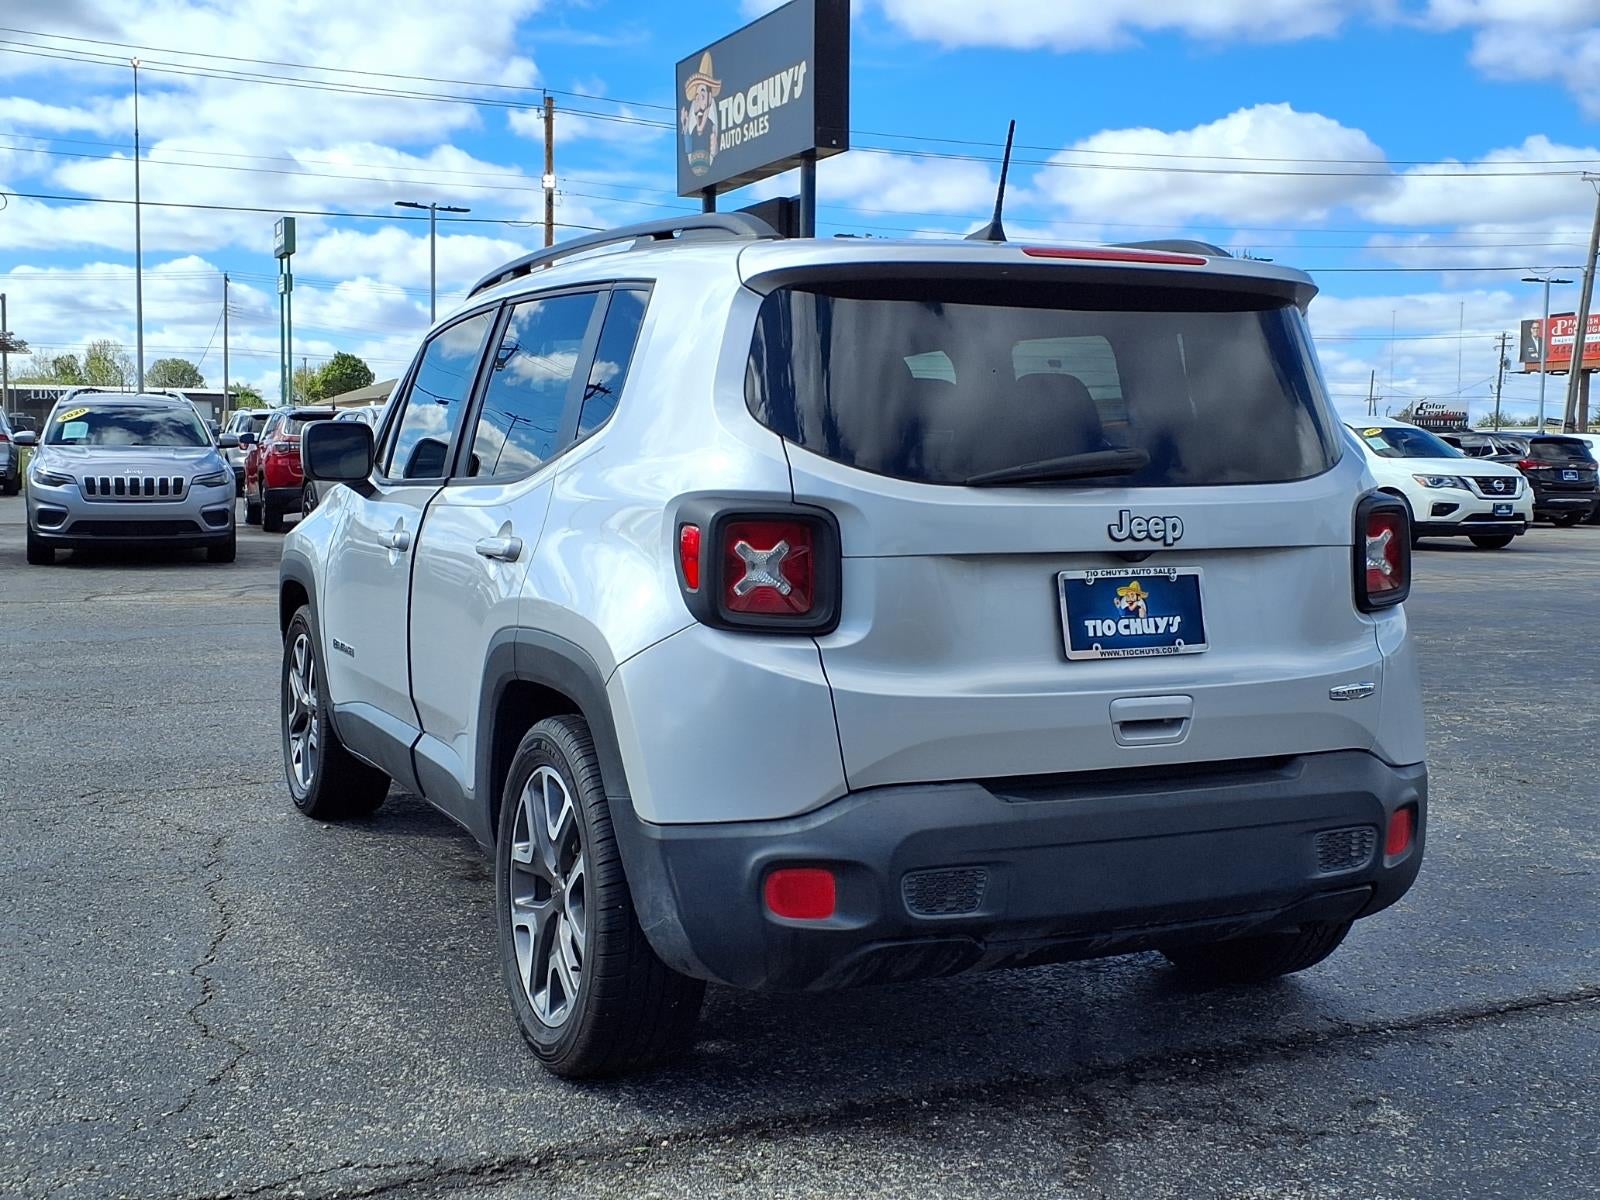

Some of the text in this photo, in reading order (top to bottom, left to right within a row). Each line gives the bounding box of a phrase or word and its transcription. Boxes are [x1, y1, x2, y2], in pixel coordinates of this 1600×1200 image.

[718, 60, 807, 131] TIO CHUY'S
[720, 115, 769, 151] AUTO SALES
[1415, 407, 1467, 417] Creations
[1419, 401, 1446, 410] Color
[61, 408, 86, 421] 2020
[1108, 509, 1184, 547] Jeep
[1085, 567, 1177, 577] TIO CHUY'S AUTO SALES
[1084, 615, 1182, 637] TIO CHUY'S
[1100, 646, 1179, 658] WWW.TIOCHUYS.COM
